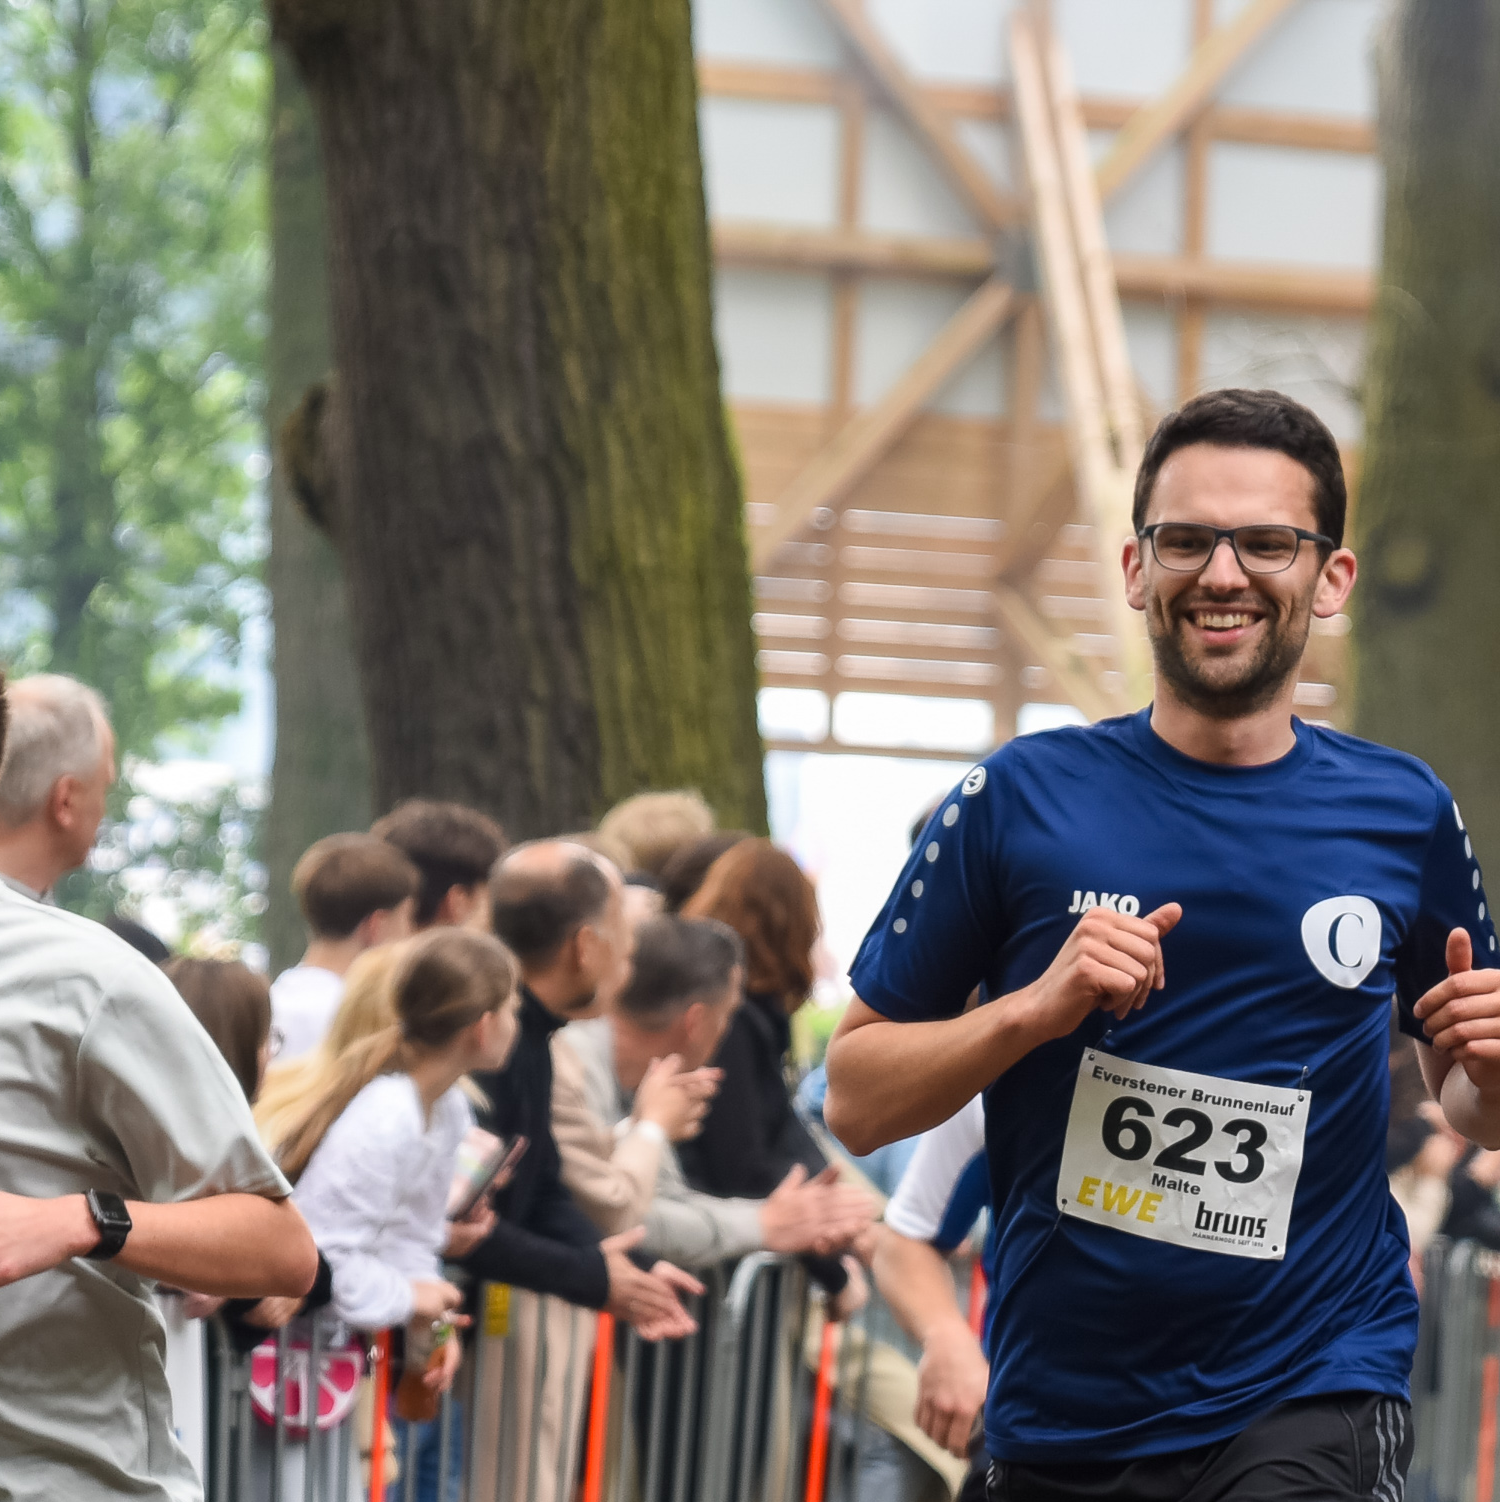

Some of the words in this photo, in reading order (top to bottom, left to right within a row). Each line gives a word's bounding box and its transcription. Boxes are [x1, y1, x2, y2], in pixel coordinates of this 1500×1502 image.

[1068, 890, 1140, 917] JAKO
[1092, 1065, 1187, 1099] Everstener
[1191, 1088, 1296, 1116] Brunnenlauf
[1101, 1095, 1268, 1183] 623
[1077, 1175, 1163, 1223] EWE
[1151, 1173, 1201, 1195] Malte
[1194, 1200, 1268, 1239] bruns
